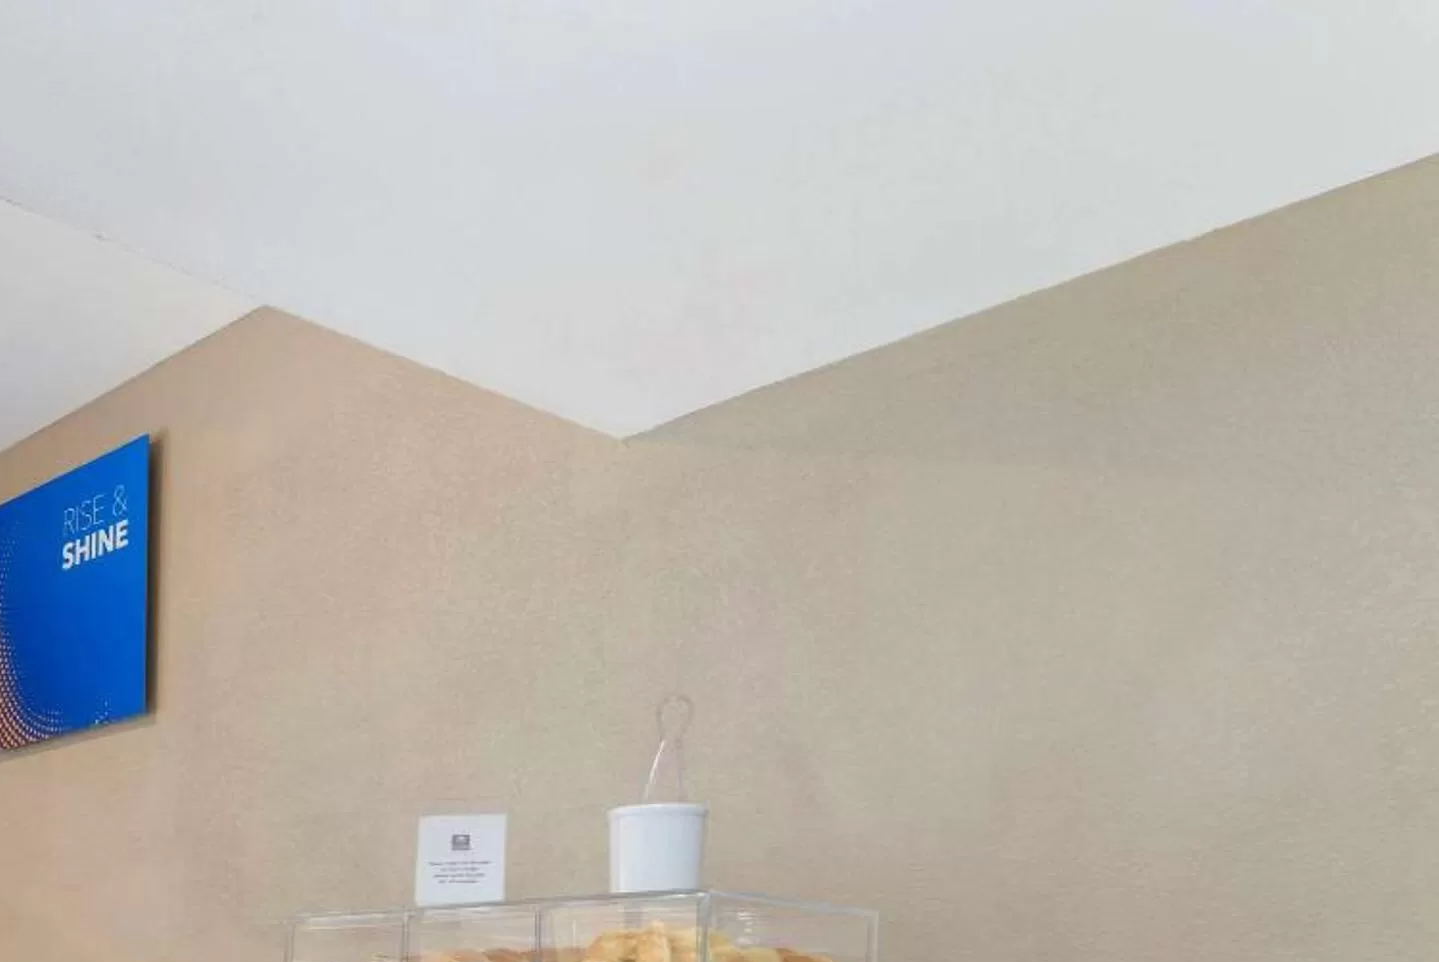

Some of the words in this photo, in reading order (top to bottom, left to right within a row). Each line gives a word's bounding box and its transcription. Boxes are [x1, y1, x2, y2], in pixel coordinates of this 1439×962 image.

[63, 494, 105, 535] RISE
[112, 484, 128, 517] &
[62, 518, 129, 570] SHINE
